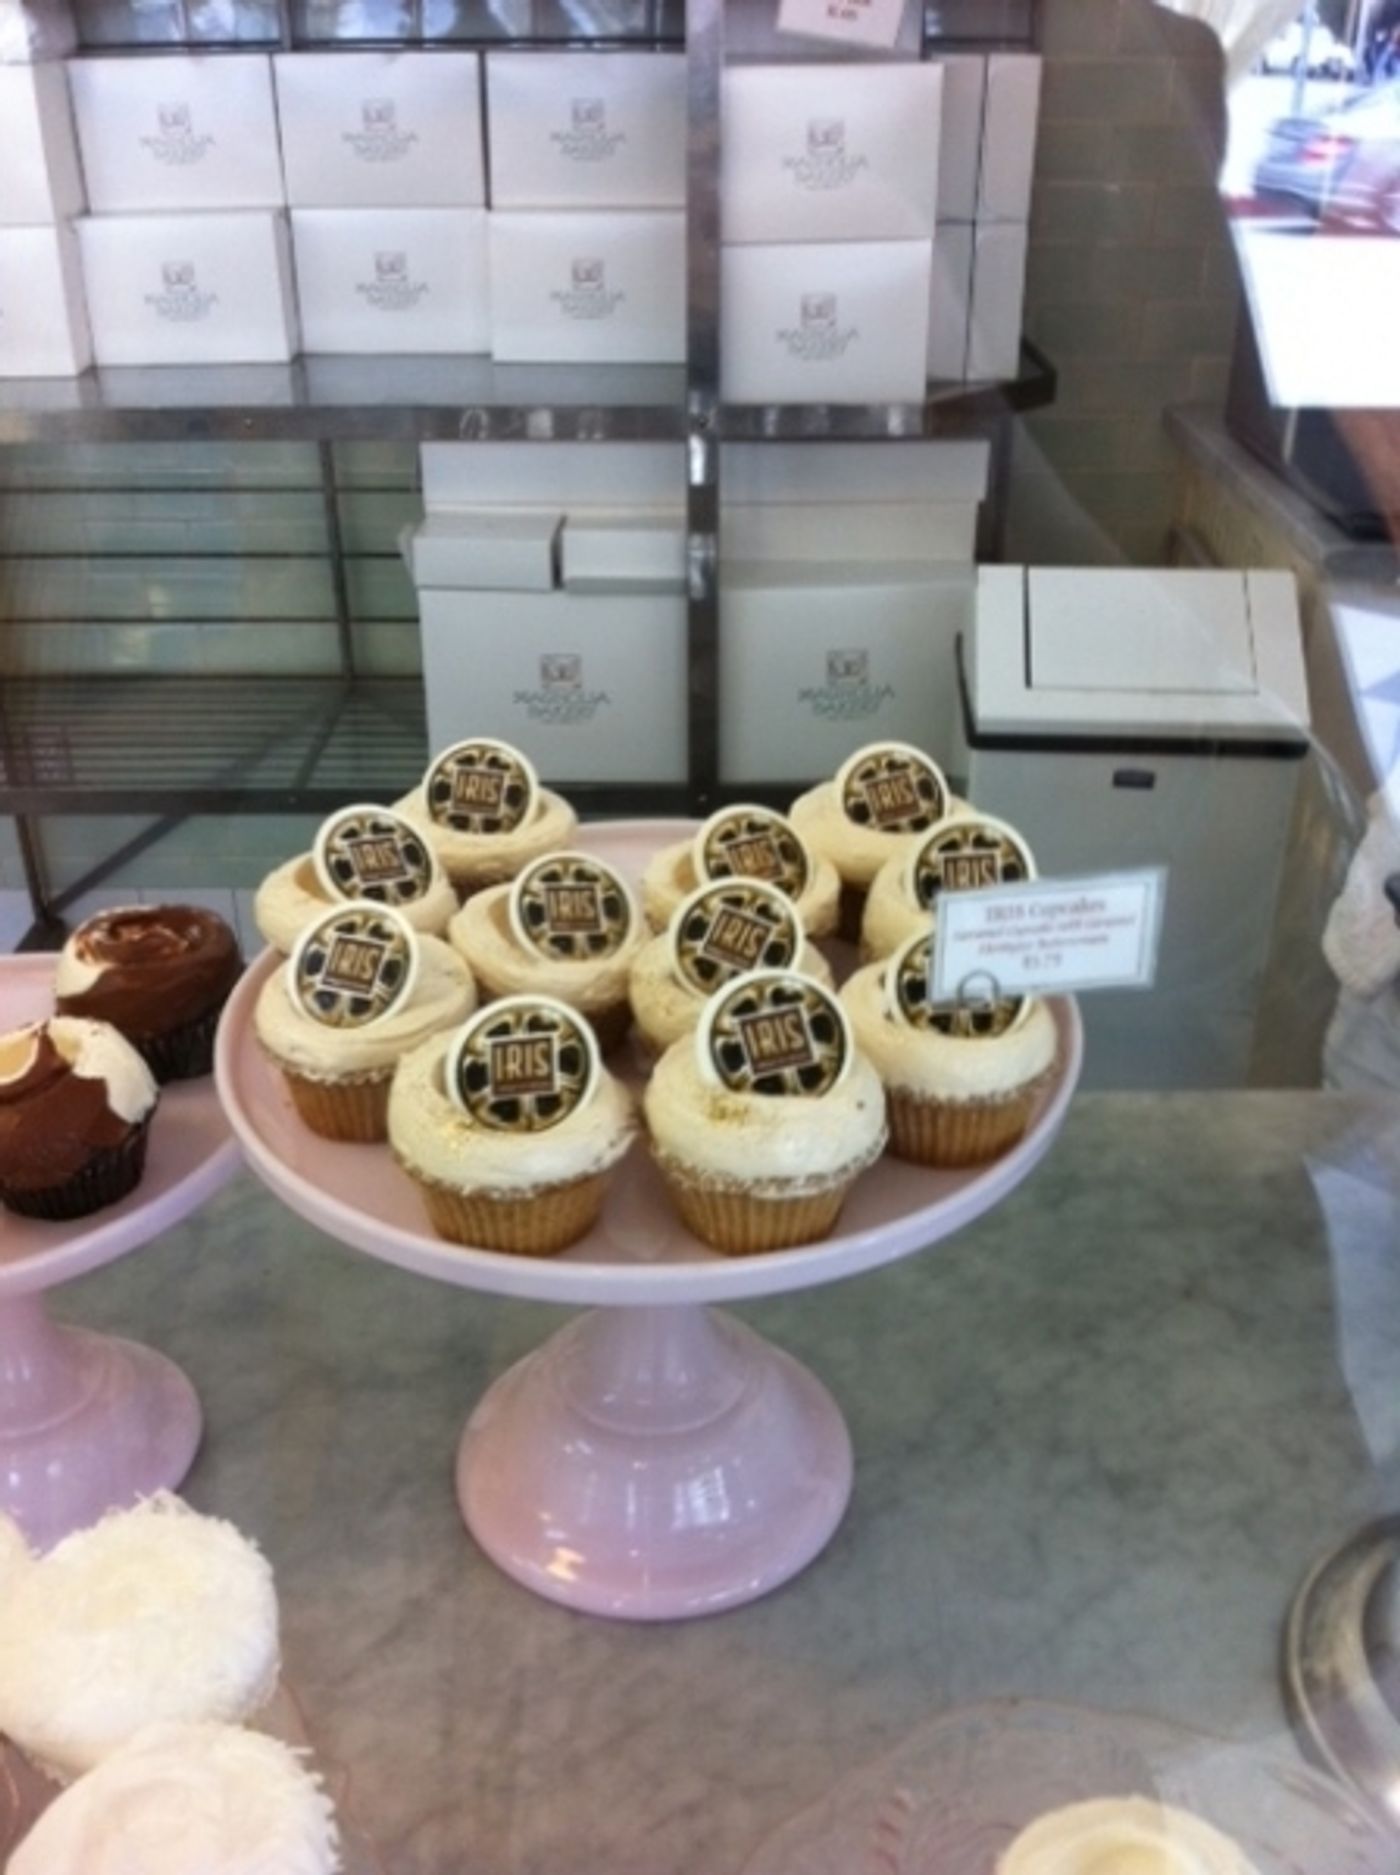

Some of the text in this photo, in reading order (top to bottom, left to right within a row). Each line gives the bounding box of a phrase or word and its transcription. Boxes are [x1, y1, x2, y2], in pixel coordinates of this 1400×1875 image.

[457, 773, 498, 803] IRIS
[867, 778, 914, 812] IRIS
[354, 841, 400, 871] IRIS
[730, 839, 777, 868] IRIS
[944, 857, 996, 886] IRIS
[549, 888, 595, 919] IRIS
[713, 913, 767, 954] IRIS
[331, 940, 379, 979] IRIS
[746, 1015, 804, 1056] IRIS
[496, 1040, 550, 1078] IRIS
